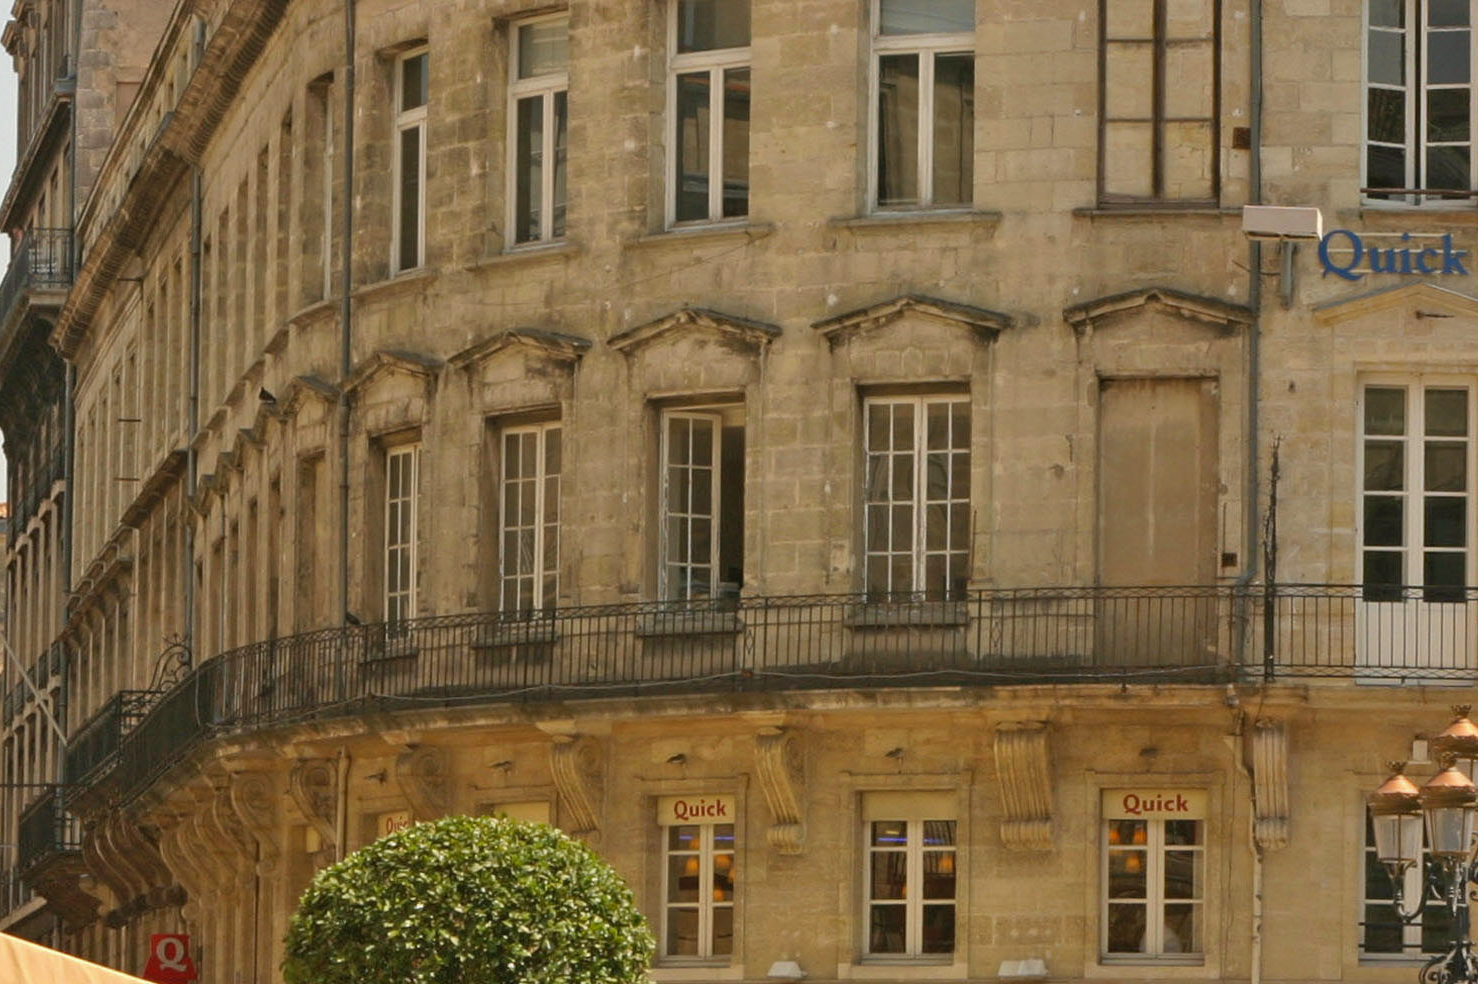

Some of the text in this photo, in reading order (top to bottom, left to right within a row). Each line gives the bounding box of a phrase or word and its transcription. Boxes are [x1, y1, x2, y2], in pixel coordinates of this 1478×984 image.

[1318, 229, 1469, 281] Quick
[674, 798, 726, 820] Quick
[1123, 794, 1189, 815] Quick
[156, 937, 187, 972] Q
